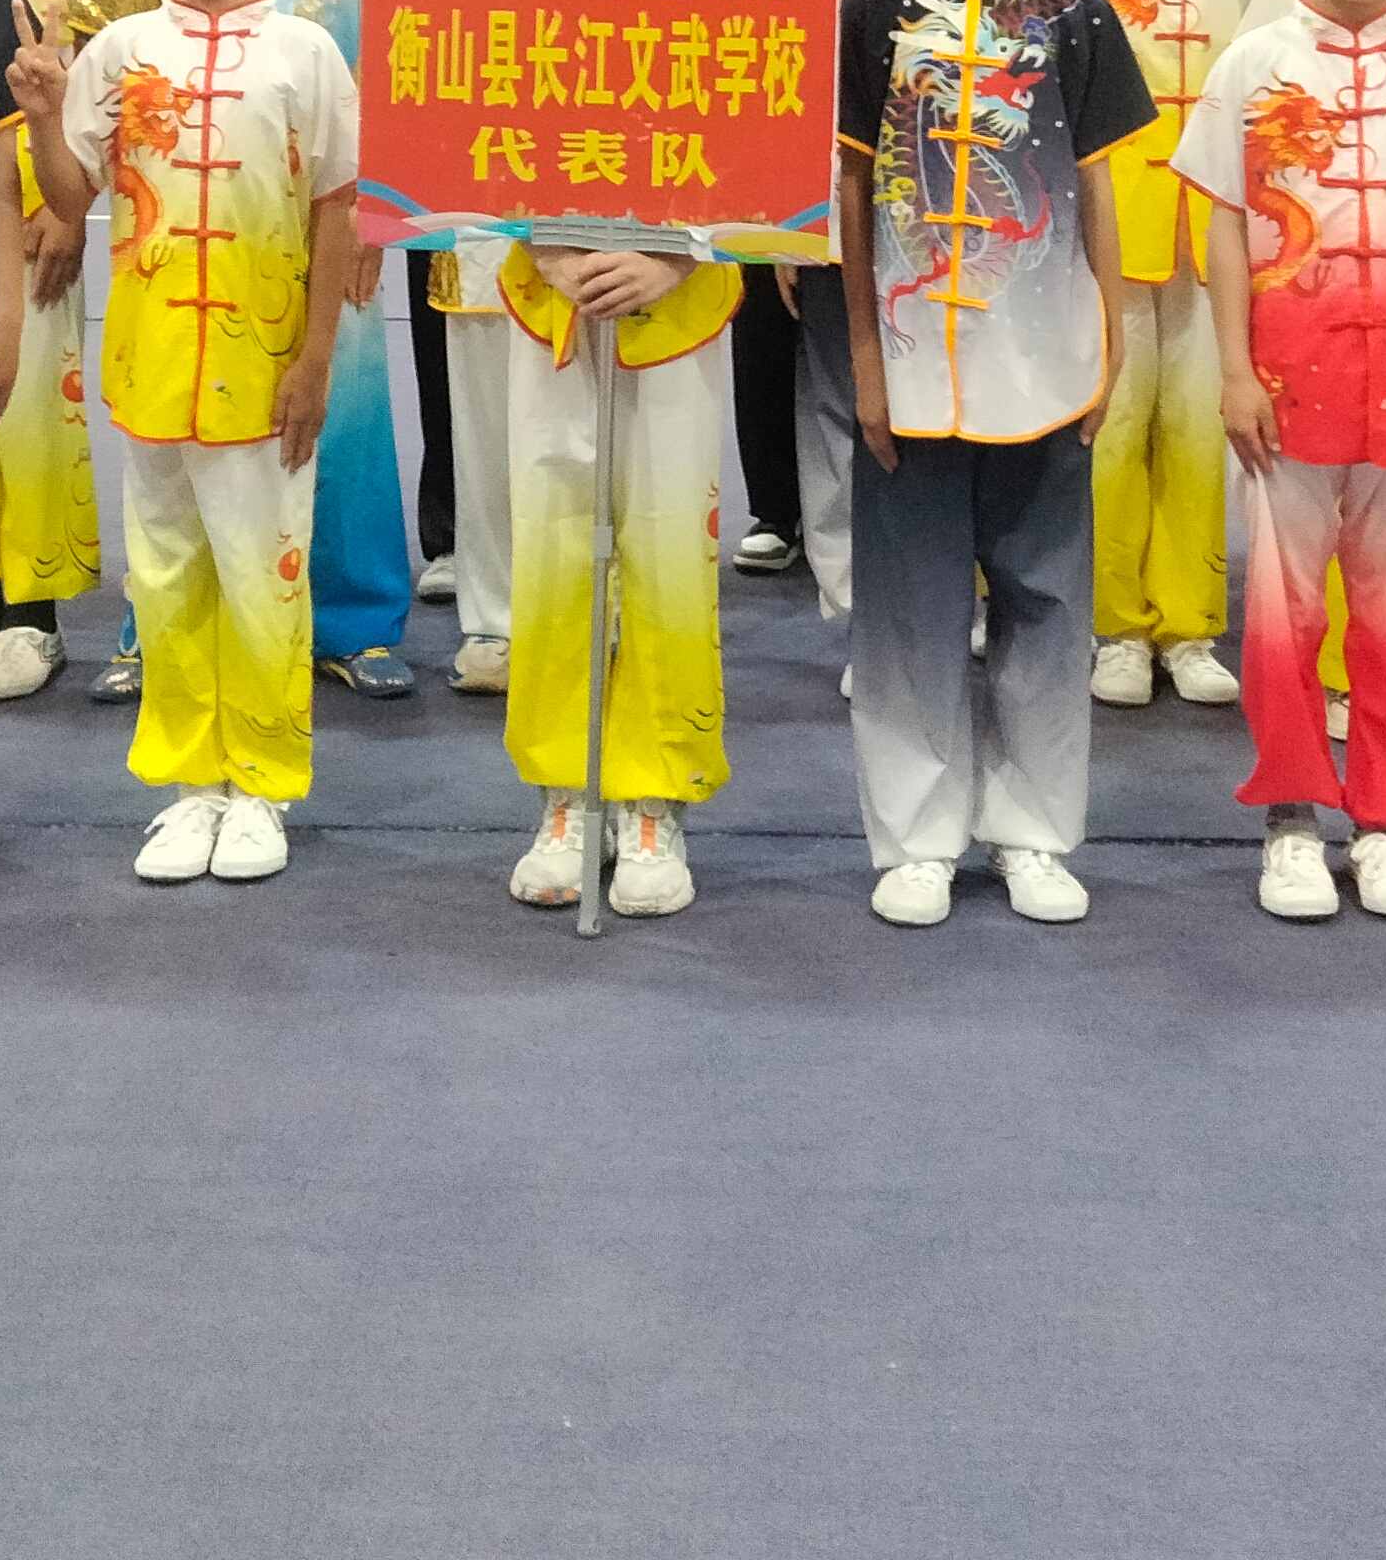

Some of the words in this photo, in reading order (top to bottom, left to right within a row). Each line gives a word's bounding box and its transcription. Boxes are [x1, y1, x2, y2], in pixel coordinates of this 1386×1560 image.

[387, 6, 808, 118] 衡山县长江文武学校
[468, 125, 718, 190] 代表队
